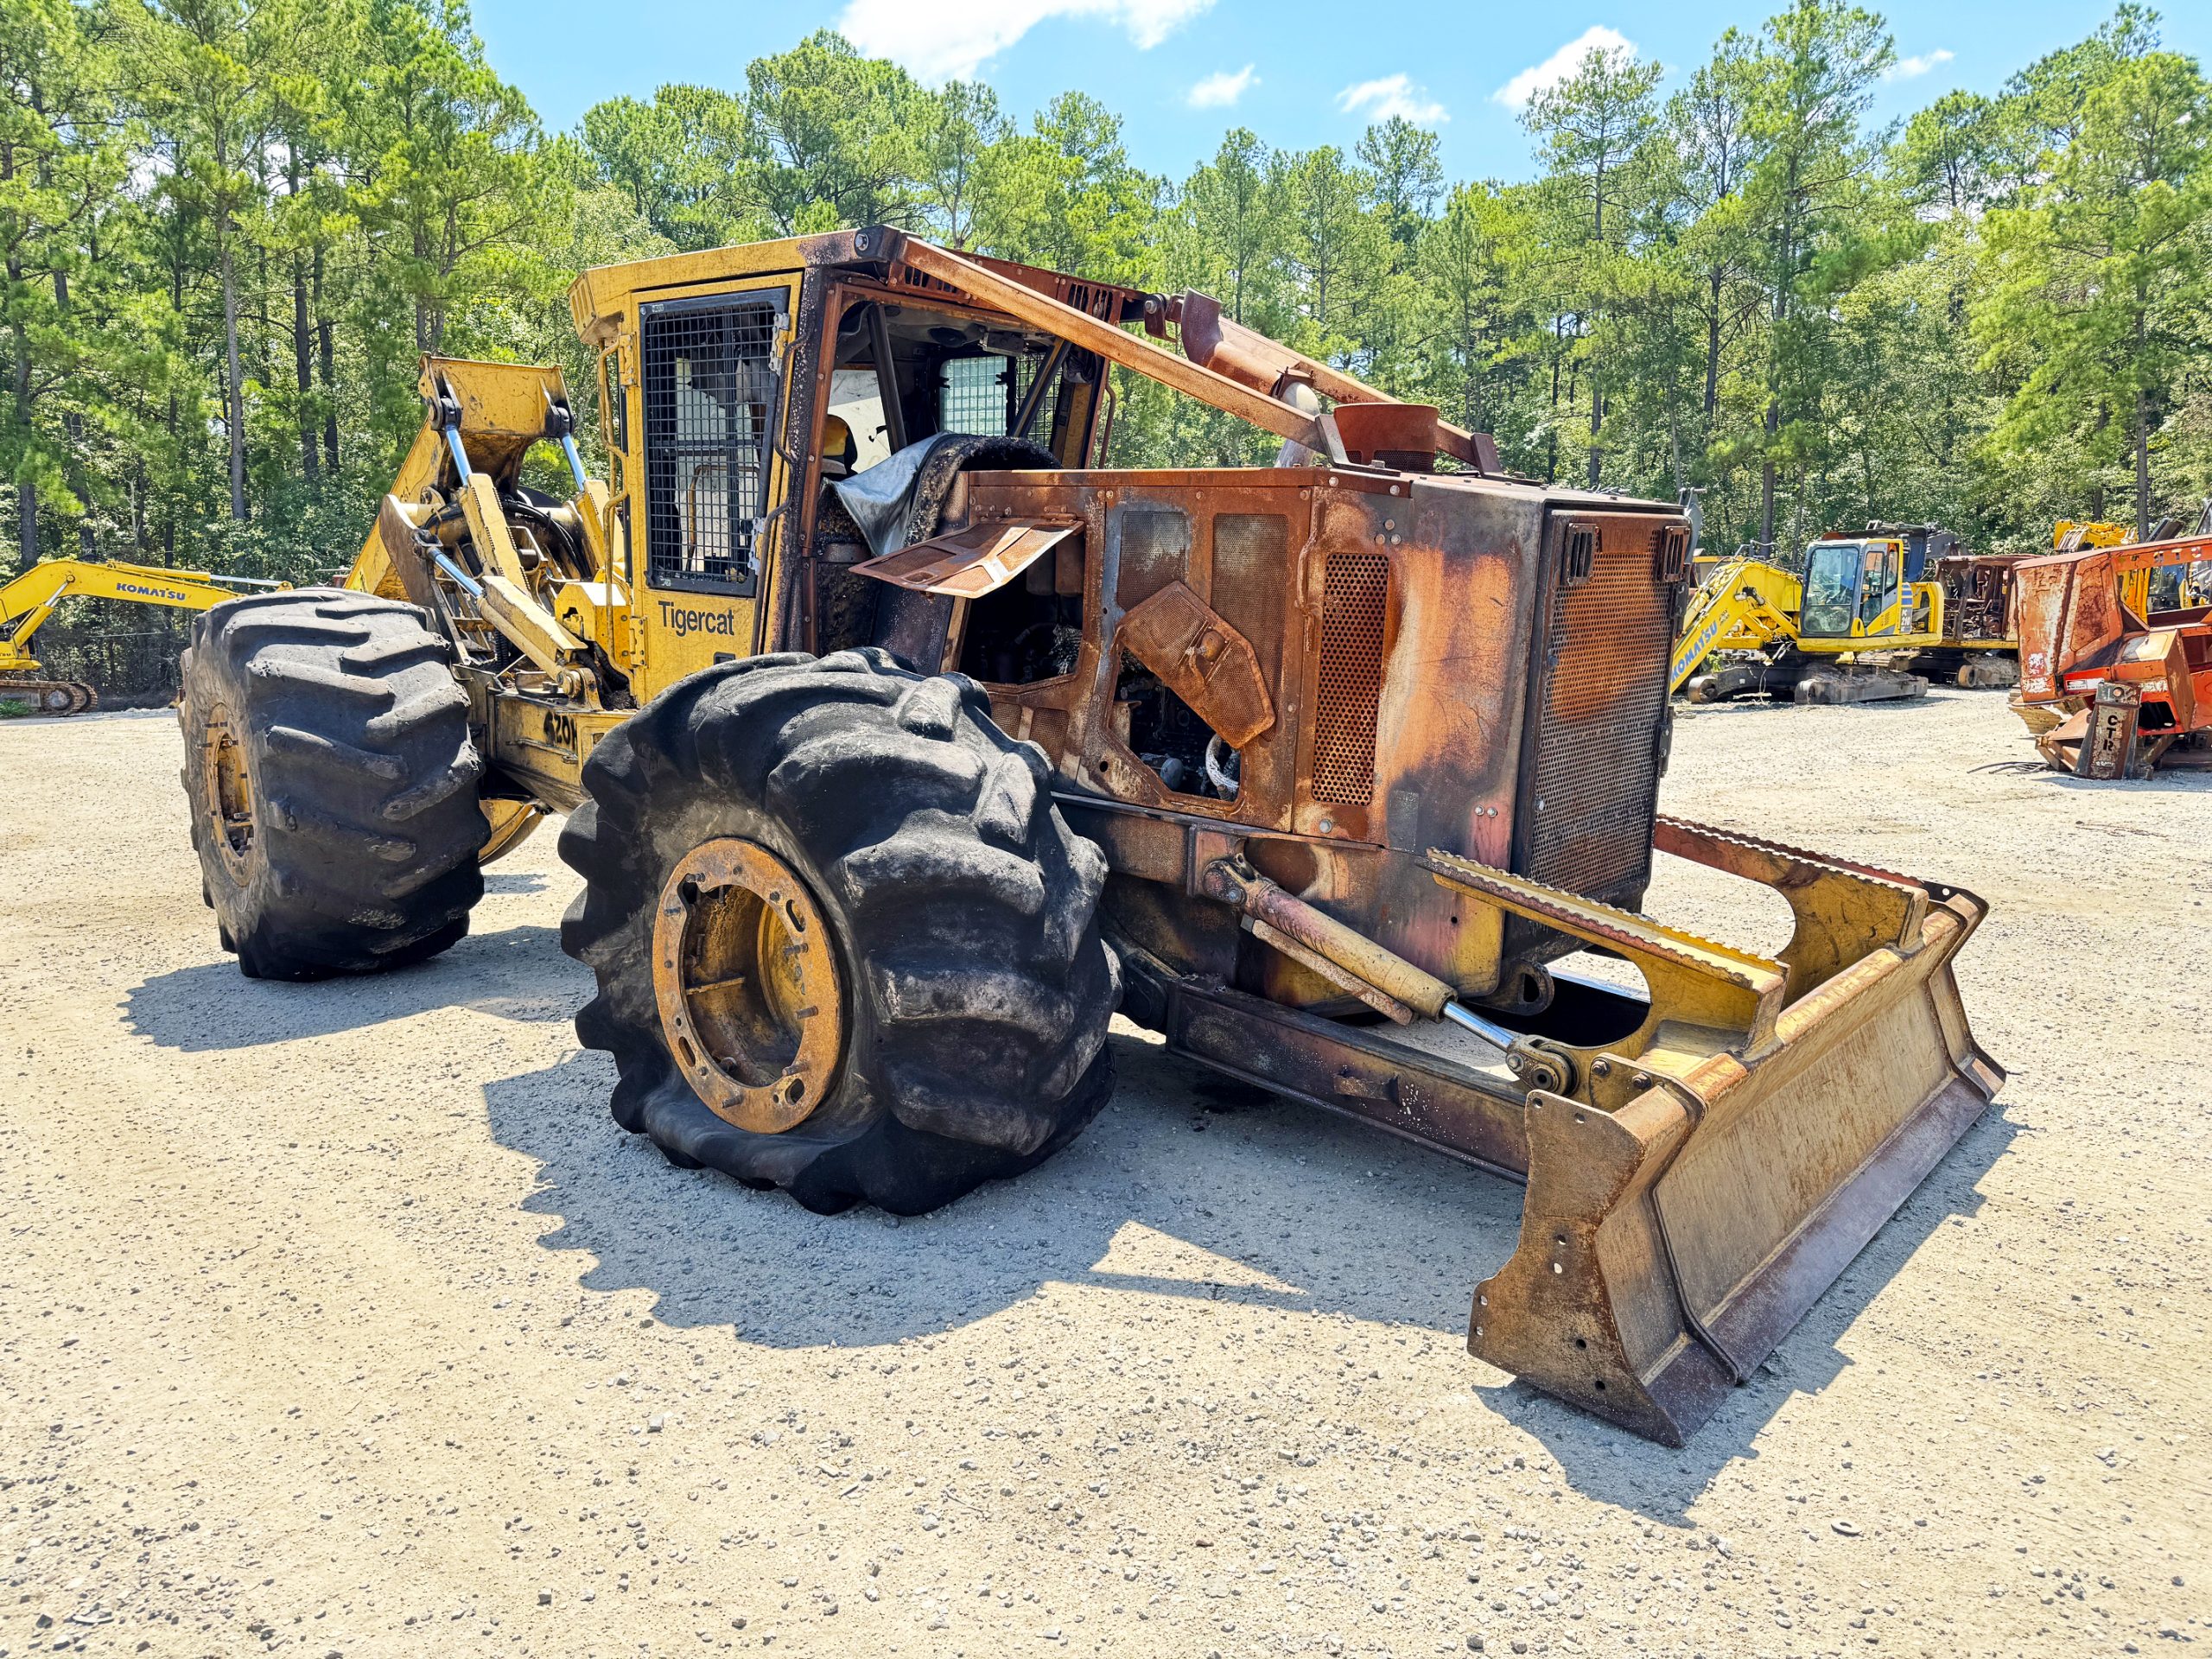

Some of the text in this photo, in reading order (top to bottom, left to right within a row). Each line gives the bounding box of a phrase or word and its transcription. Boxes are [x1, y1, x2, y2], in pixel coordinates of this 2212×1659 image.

[116, 583, 186, 601] KOMATSU
[658, 600, 734, 637] Tigercat
[1670, 620, 1718, 683] KOMATSU
